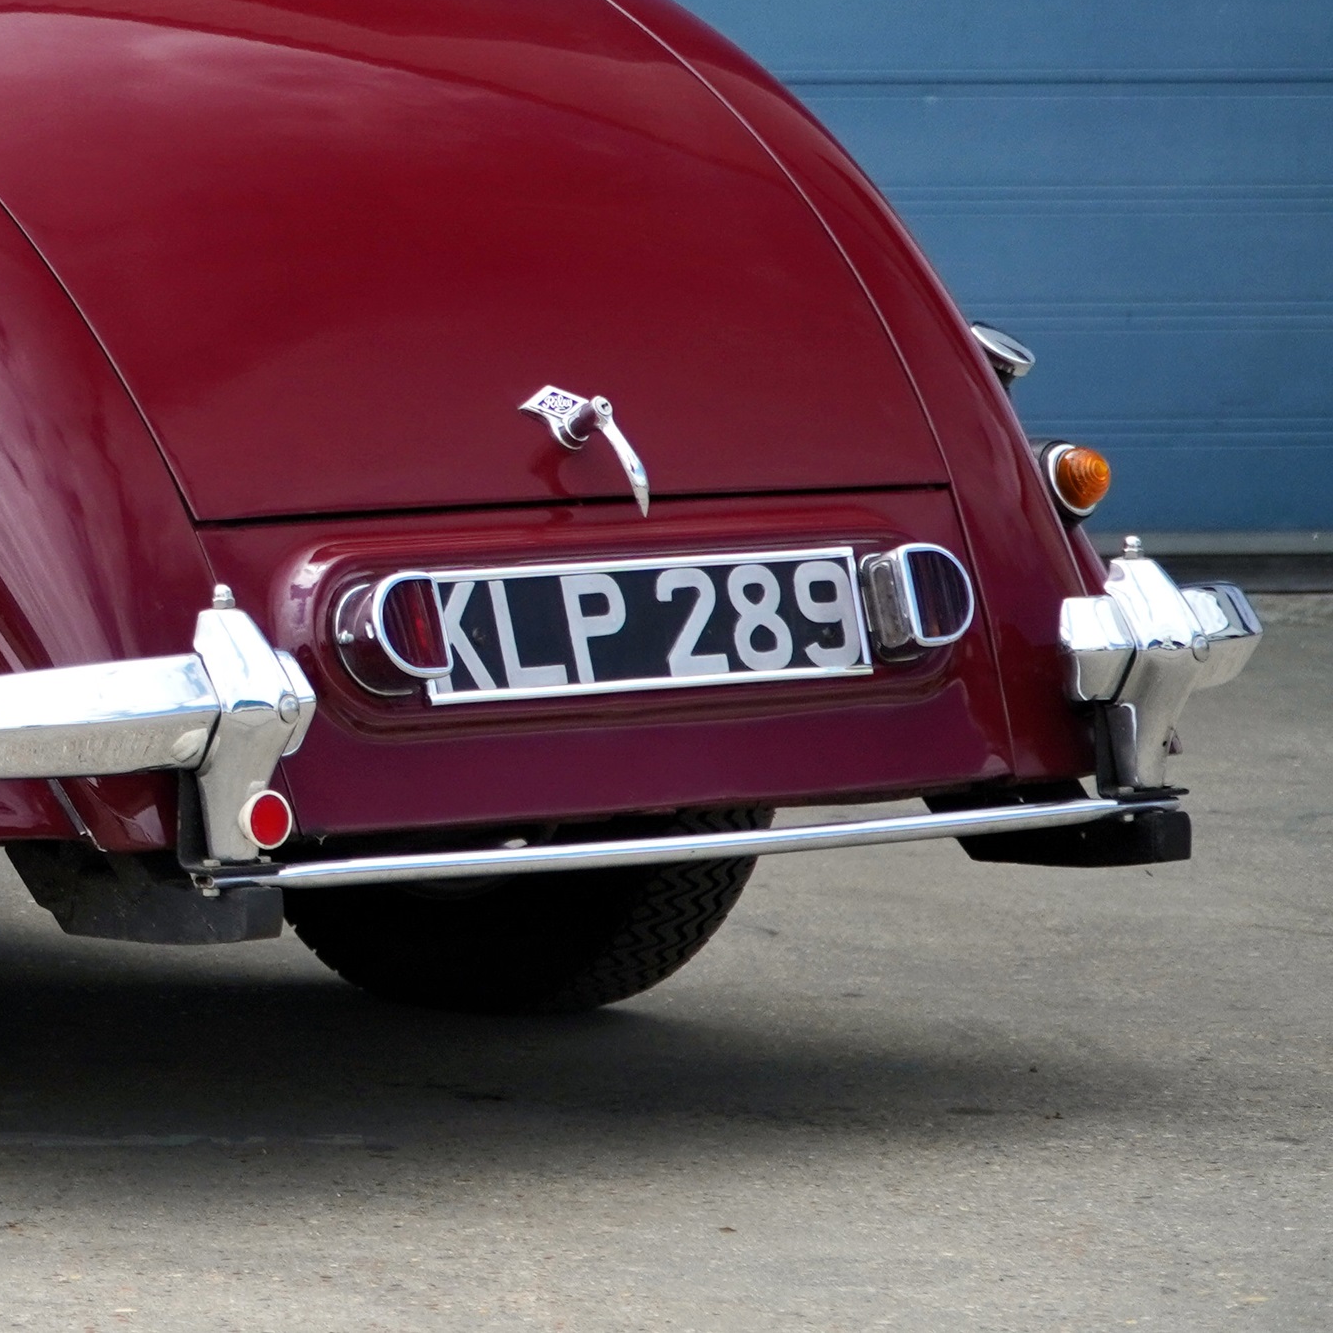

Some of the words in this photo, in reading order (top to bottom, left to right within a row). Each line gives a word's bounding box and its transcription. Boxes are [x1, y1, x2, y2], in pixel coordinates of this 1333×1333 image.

[541, 394, 573, 414] Riley
[439, 573, 627, 692] KLP
[655, 560, 862, 677] 289
